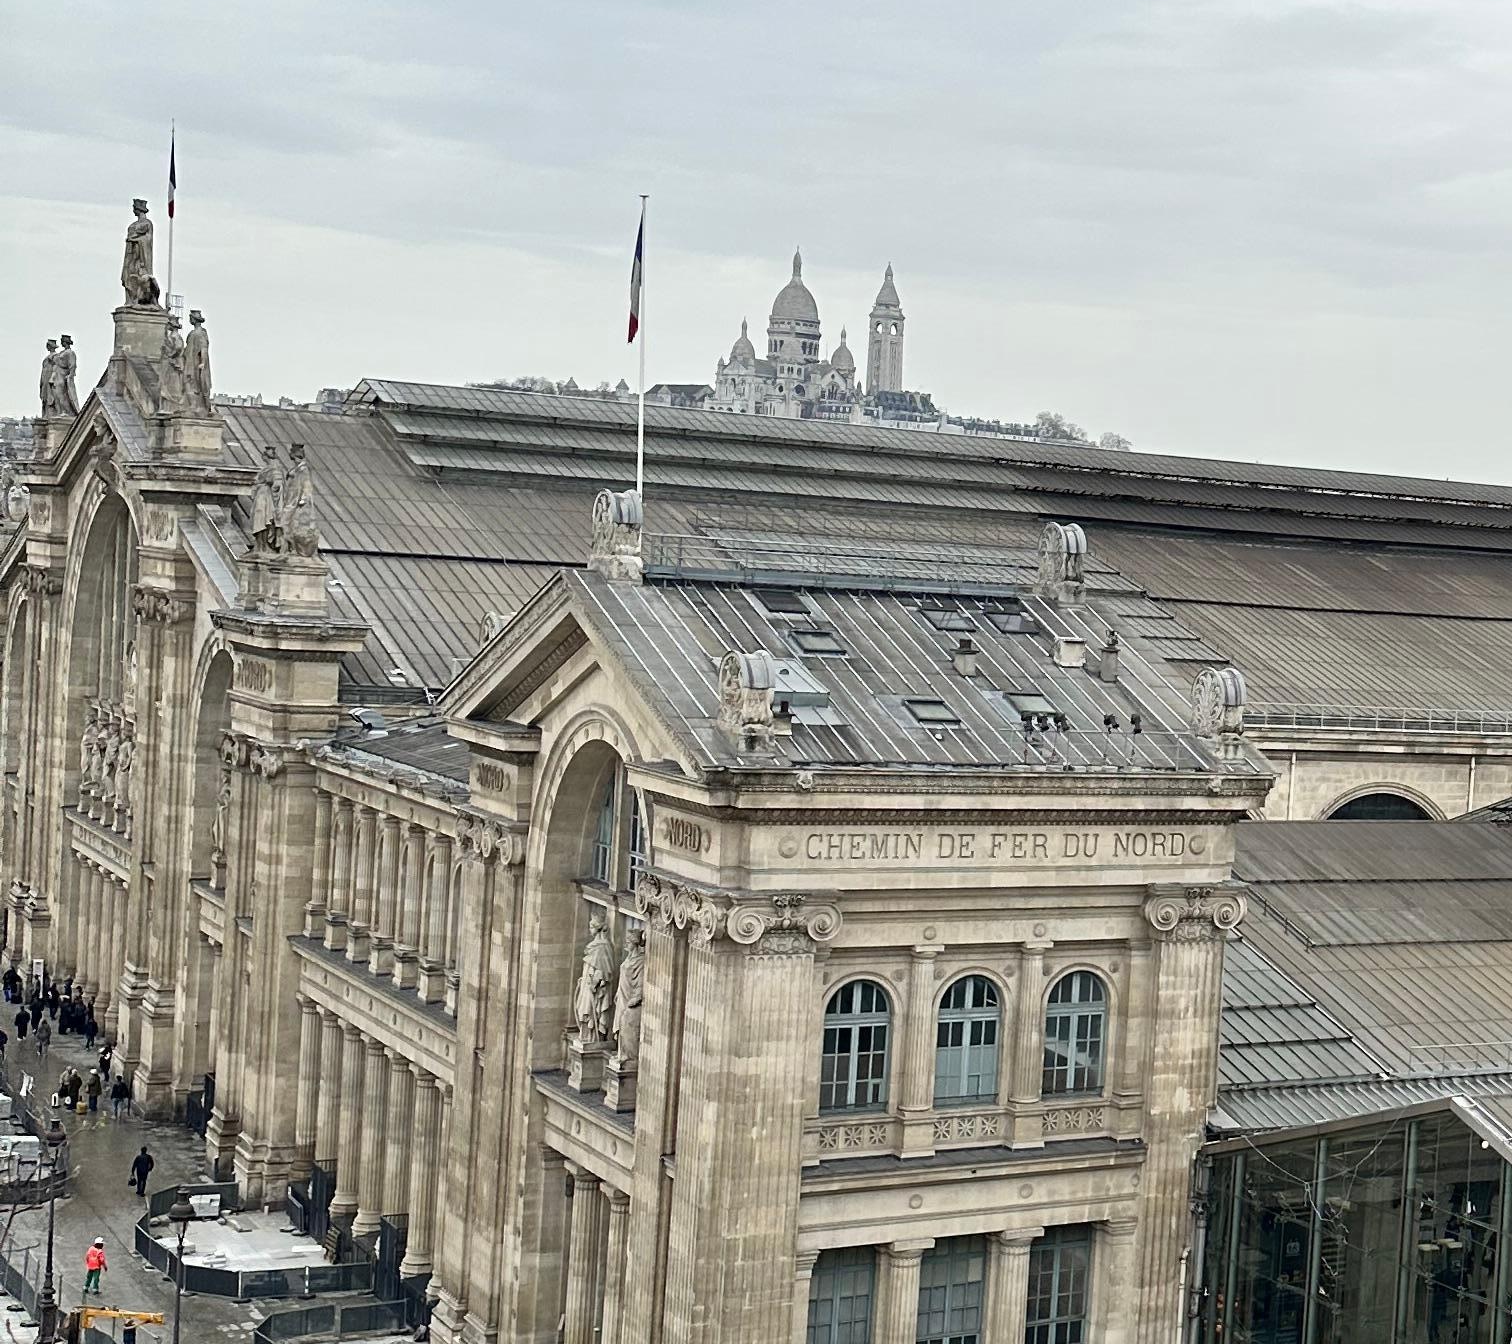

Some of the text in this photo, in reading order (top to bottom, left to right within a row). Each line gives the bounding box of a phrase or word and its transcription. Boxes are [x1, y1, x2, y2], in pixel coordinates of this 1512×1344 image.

[667, 816, 701, 853] NORD
[805, 832, 1186, 860] CHEMIN DE FER DU NORD
